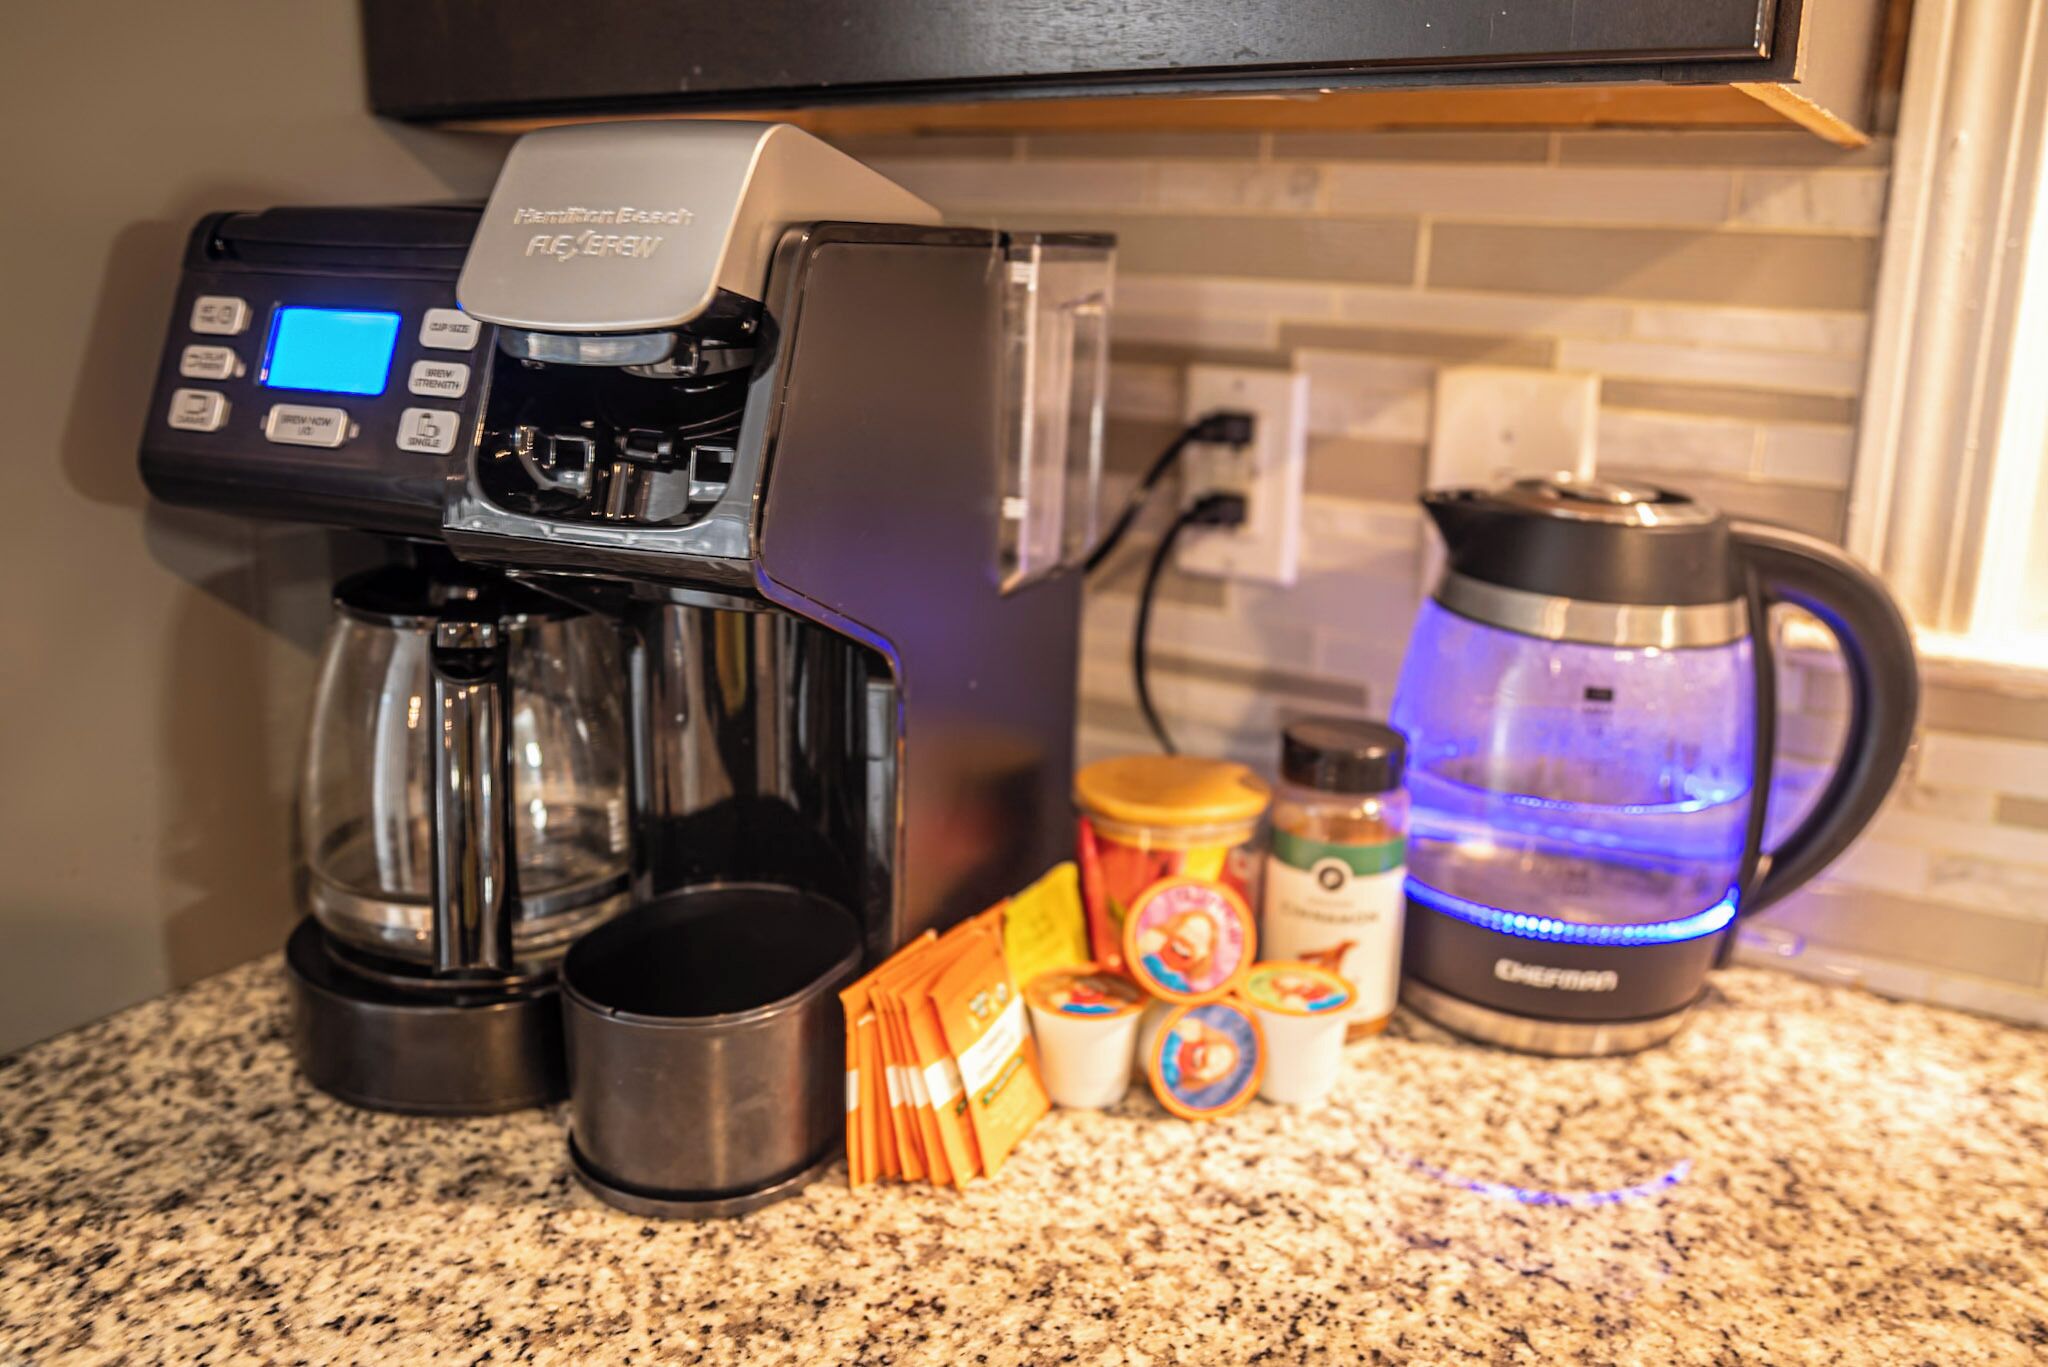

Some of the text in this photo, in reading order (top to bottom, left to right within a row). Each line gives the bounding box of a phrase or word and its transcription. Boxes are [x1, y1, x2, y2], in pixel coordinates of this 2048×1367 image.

[513, 207, 694, 225] Hamilton Beach
[429, 322, 471, 334] CUP SIZE
[425, 368, 456, 378] BREW
[413, 379, 460, 391] STRENGTH
[407, 437, 441, 448] SINGLE
[1494, 958, 1618, 991] CHEFMAN
